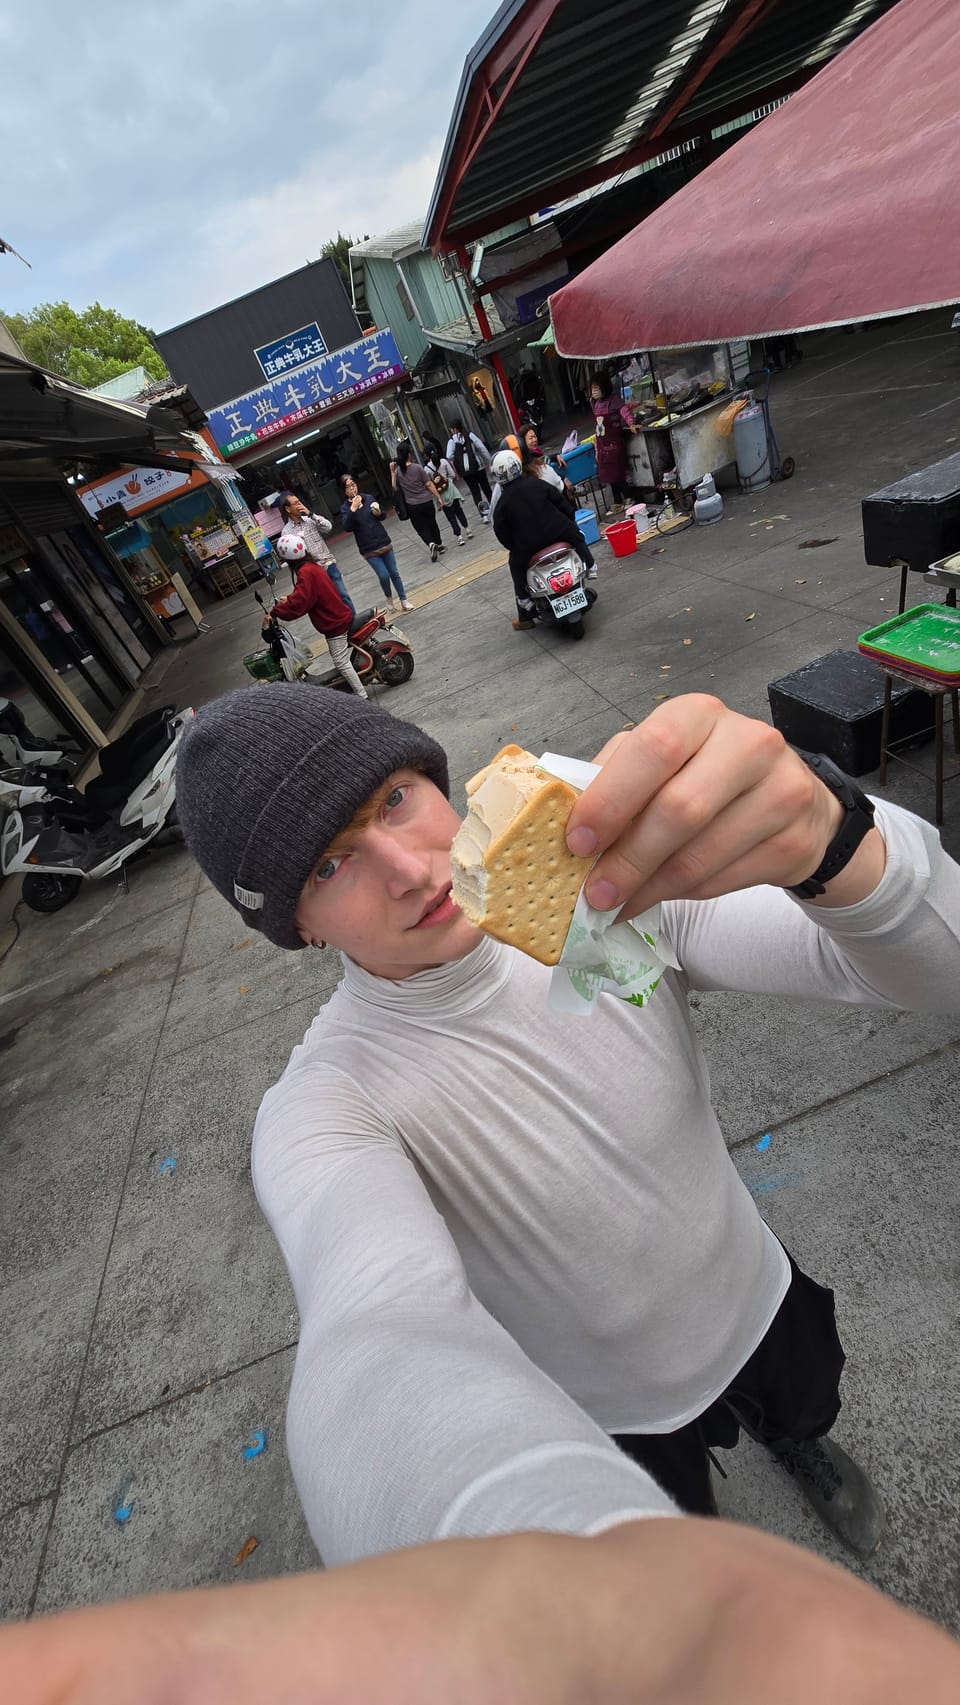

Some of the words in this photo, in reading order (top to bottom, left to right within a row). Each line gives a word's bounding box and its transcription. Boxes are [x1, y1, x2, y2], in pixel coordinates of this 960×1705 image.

[264, 339, 324, 375] 正典牛乳大王
[225, 346, 390, 438] 正典牛乳大王
